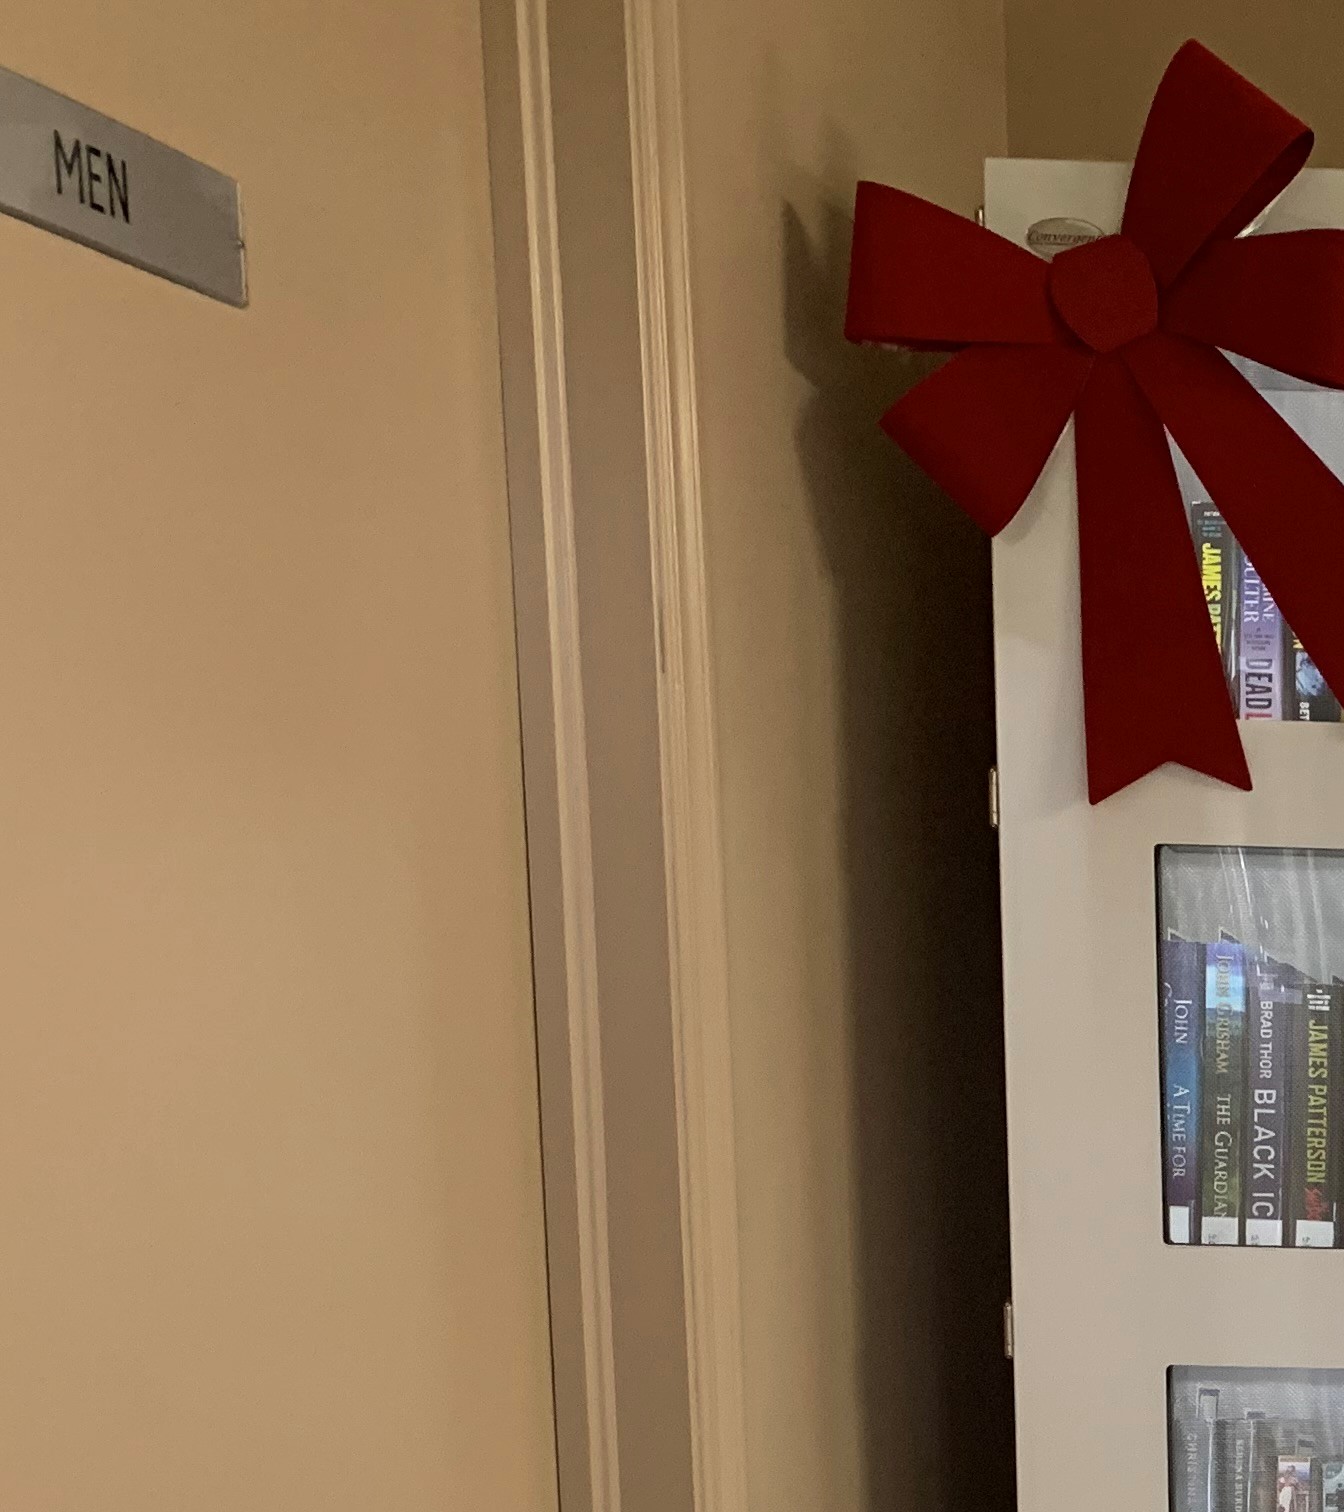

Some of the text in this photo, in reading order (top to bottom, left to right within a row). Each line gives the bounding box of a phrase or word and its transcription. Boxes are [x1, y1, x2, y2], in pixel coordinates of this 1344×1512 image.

[54, 129, 132, 224] MEN
[1201, 543, 1222, 601] JAMES
[1174, 999, 1192, 1044] JOHN
[1173, 1084, 1190, 1097] A
[1253, 1001, 1276, 1179] BRAD THOR BLACK
[1307, 1020, 1328, 1183] JAMES PATTERSON
[1172, 1147, 1187, 1177] FOR
